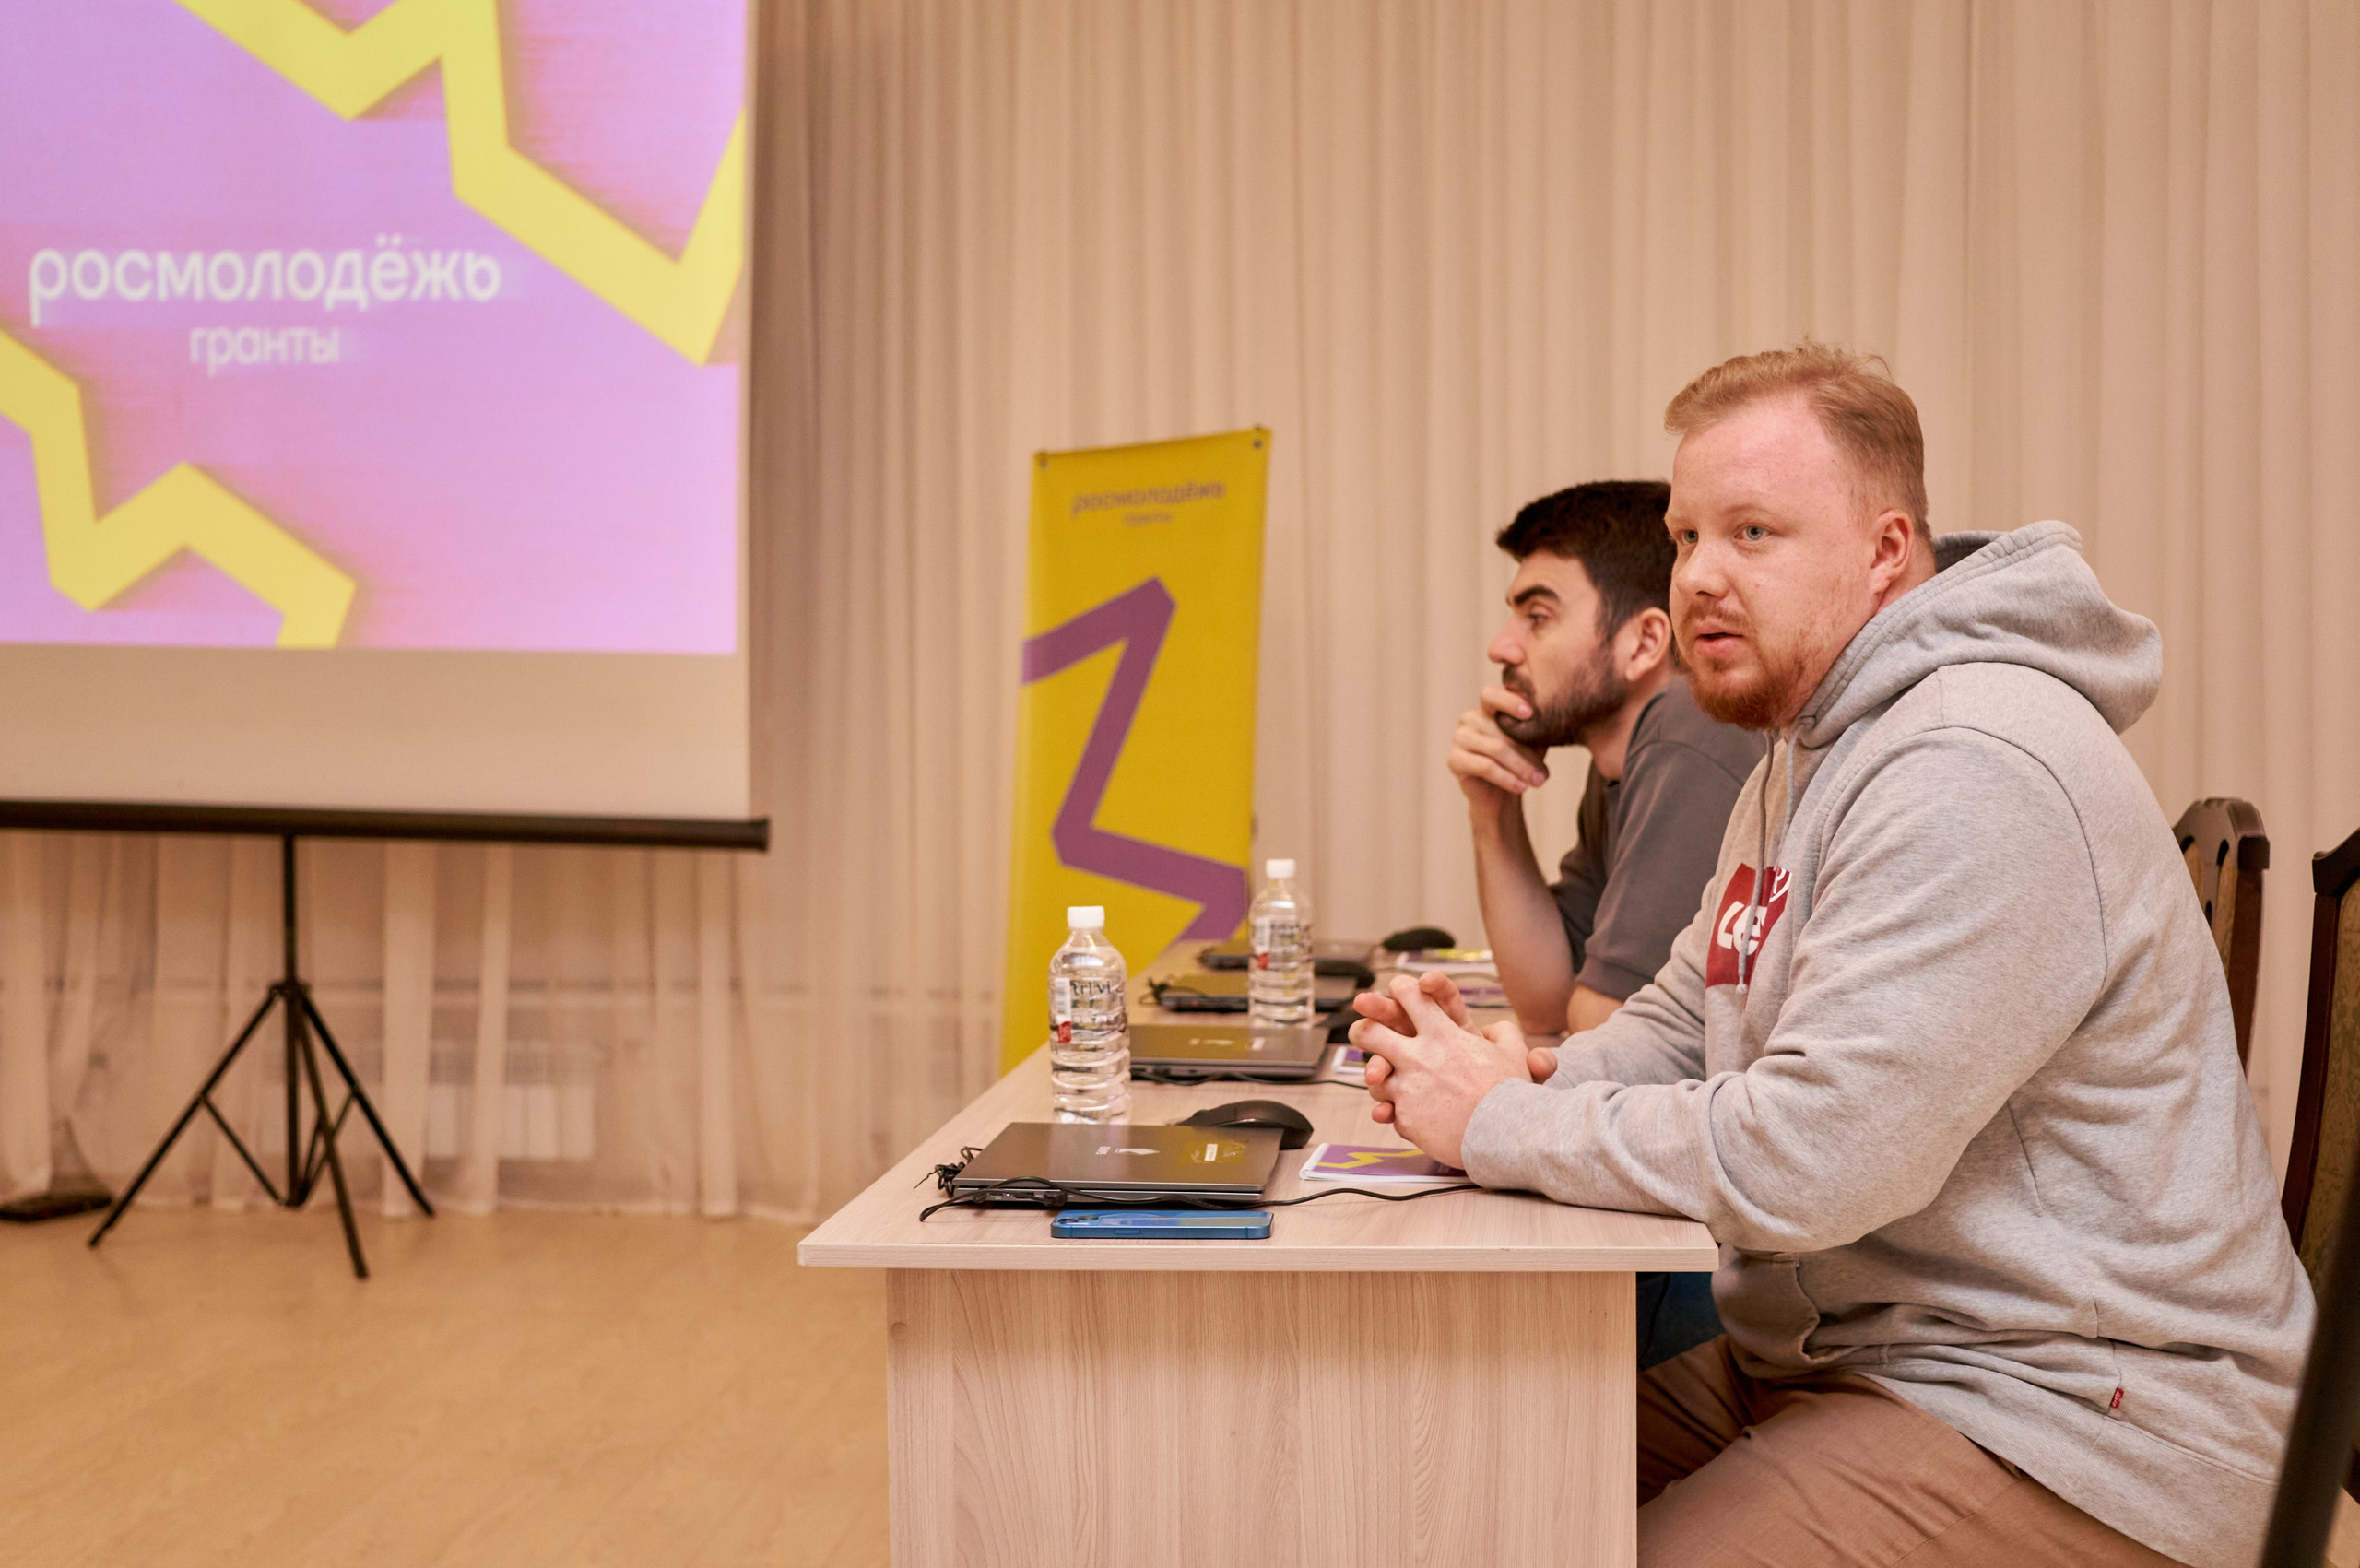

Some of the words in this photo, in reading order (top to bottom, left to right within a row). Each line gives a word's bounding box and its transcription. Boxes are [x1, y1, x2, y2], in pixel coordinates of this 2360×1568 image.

[30, 232, 502, 329] росмолодёжь
[190, 326, 340, 377] гранты
[1717, 901, 1767, 956] Le
